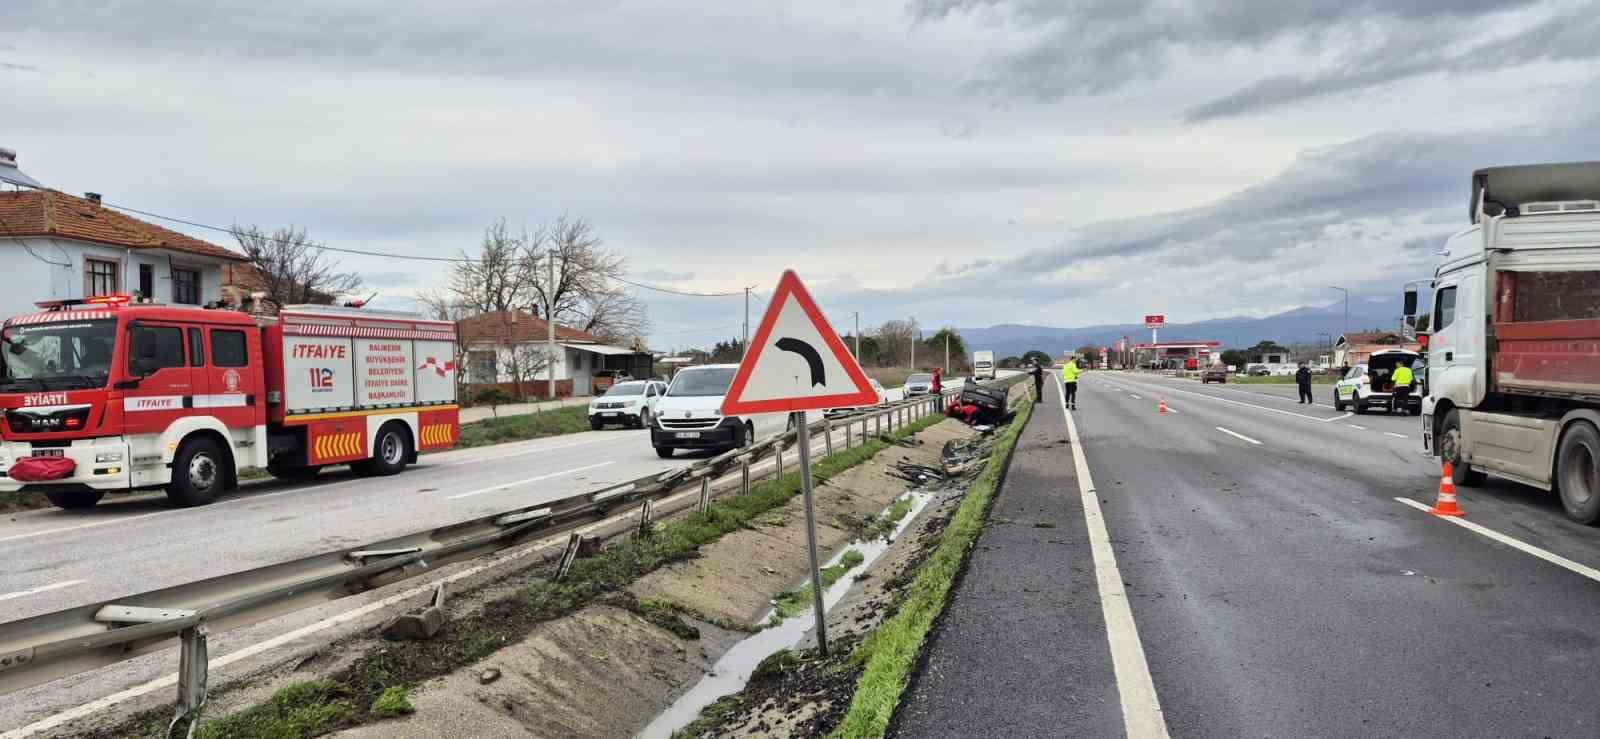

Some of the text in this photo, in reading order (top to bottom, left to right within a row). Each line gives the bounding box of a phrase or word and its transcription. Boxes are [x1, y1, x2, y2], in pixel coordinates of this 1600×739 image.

[292, 344, 346, 359] İTFAİYE
[310, 367, 334, 387] 112
[31, 418, 60, 426] MAN
